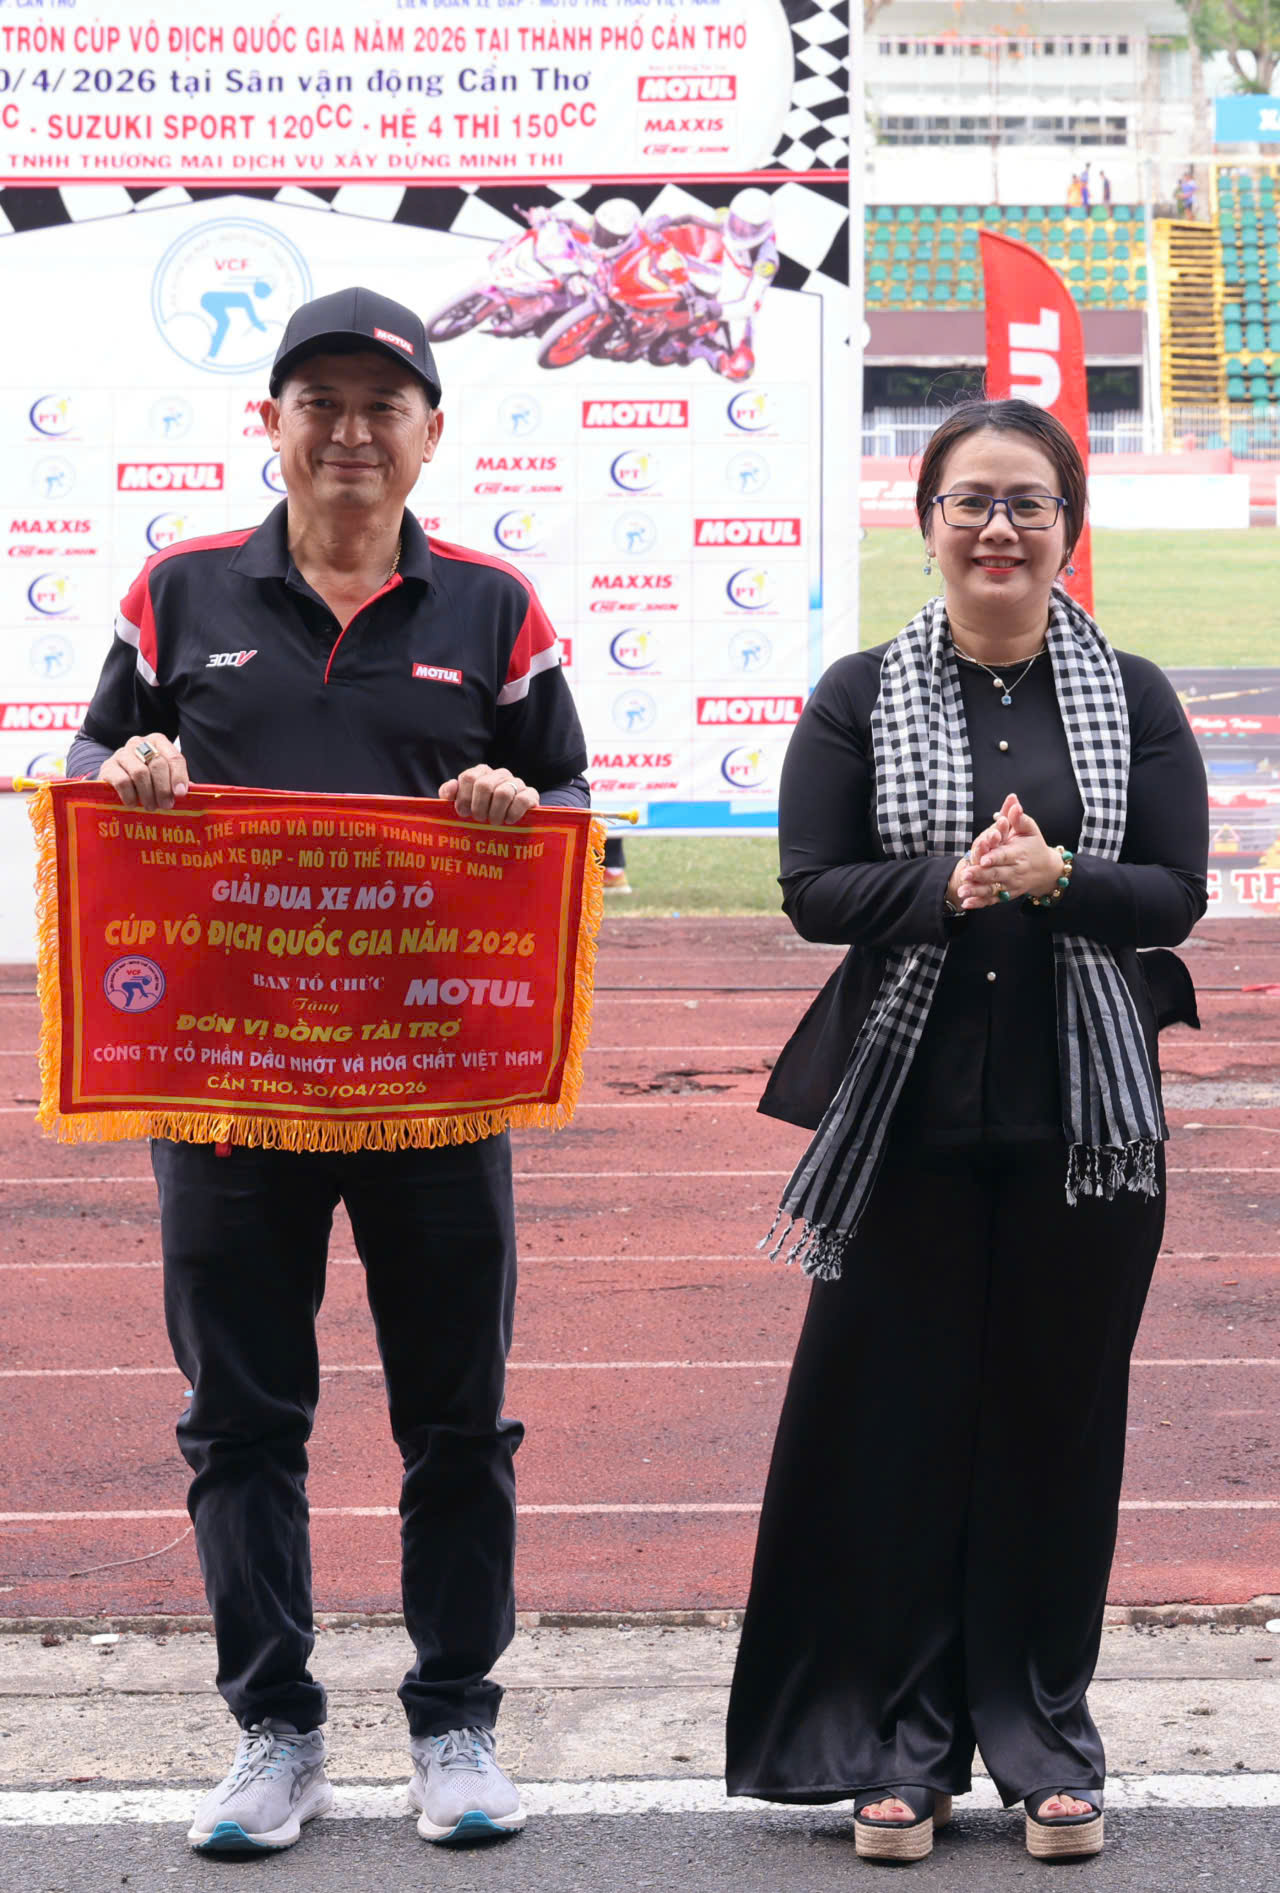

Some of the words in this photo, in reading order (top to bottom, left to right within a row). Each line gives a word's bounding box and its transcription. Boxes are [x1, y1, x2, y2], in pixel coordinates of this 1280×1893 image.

[414, 26, 466, 52] 2026
[170, 68, 211, 99] tại
[225, 68, 284, 93] Sân
[298, 70, 352, 99] vận
[367, 68, 443, 98] động
[458, 64, 517, 93] Cần
[531, 67, 592, 92] Thơ
[641, 77, 734, 100] MOTUL
[48, 114, 153, 139] SUZUKI
[164, 114, 256, 139] SPORT
[381, 107, 417, 147] HỆ
[428, 114, 443, 138] 4
[645, 118, 724, 132] MAXXIS
[214, 259, 249, 271] VCF
[377, 330, 413, 353] MOTUL
[586, 403, 684, 426] MOTUL
[476, 457, 557, 470] MAXXIS
[122, 466, 220, 489] MOTUL
[10, 519, 91, 533] MAXXIS
[698, 521, 797, 544] MOTUL
[592, 574, 672, 588] MAXXIS
[206, 650, 257, 667] 300V
[415, 666, 459, 681] MOTUL
[700, 699, 799, 722] MOTUL
[404, 979, 534, 1007] MOTUL
[93, 1044, 140, 1062] CÔNG
[147, 1046, 168, 1063] TY
[174, 1041, 195, 1063] CỔ
[201, 1044, 243, 1066] PHẦN
[250, 1048, 285, 1068] DẦU
[291, 1055, 337, 1073] NHỚT
[342, 1053, 364, 1072] VÀ
[371, 1052, 406, 1071] HÓA
[413, 1047, 456, 1069] CHẤT
[462, 1050, 499, 1070] VIỆT
[506, 1051, 542, 1066] NAM
